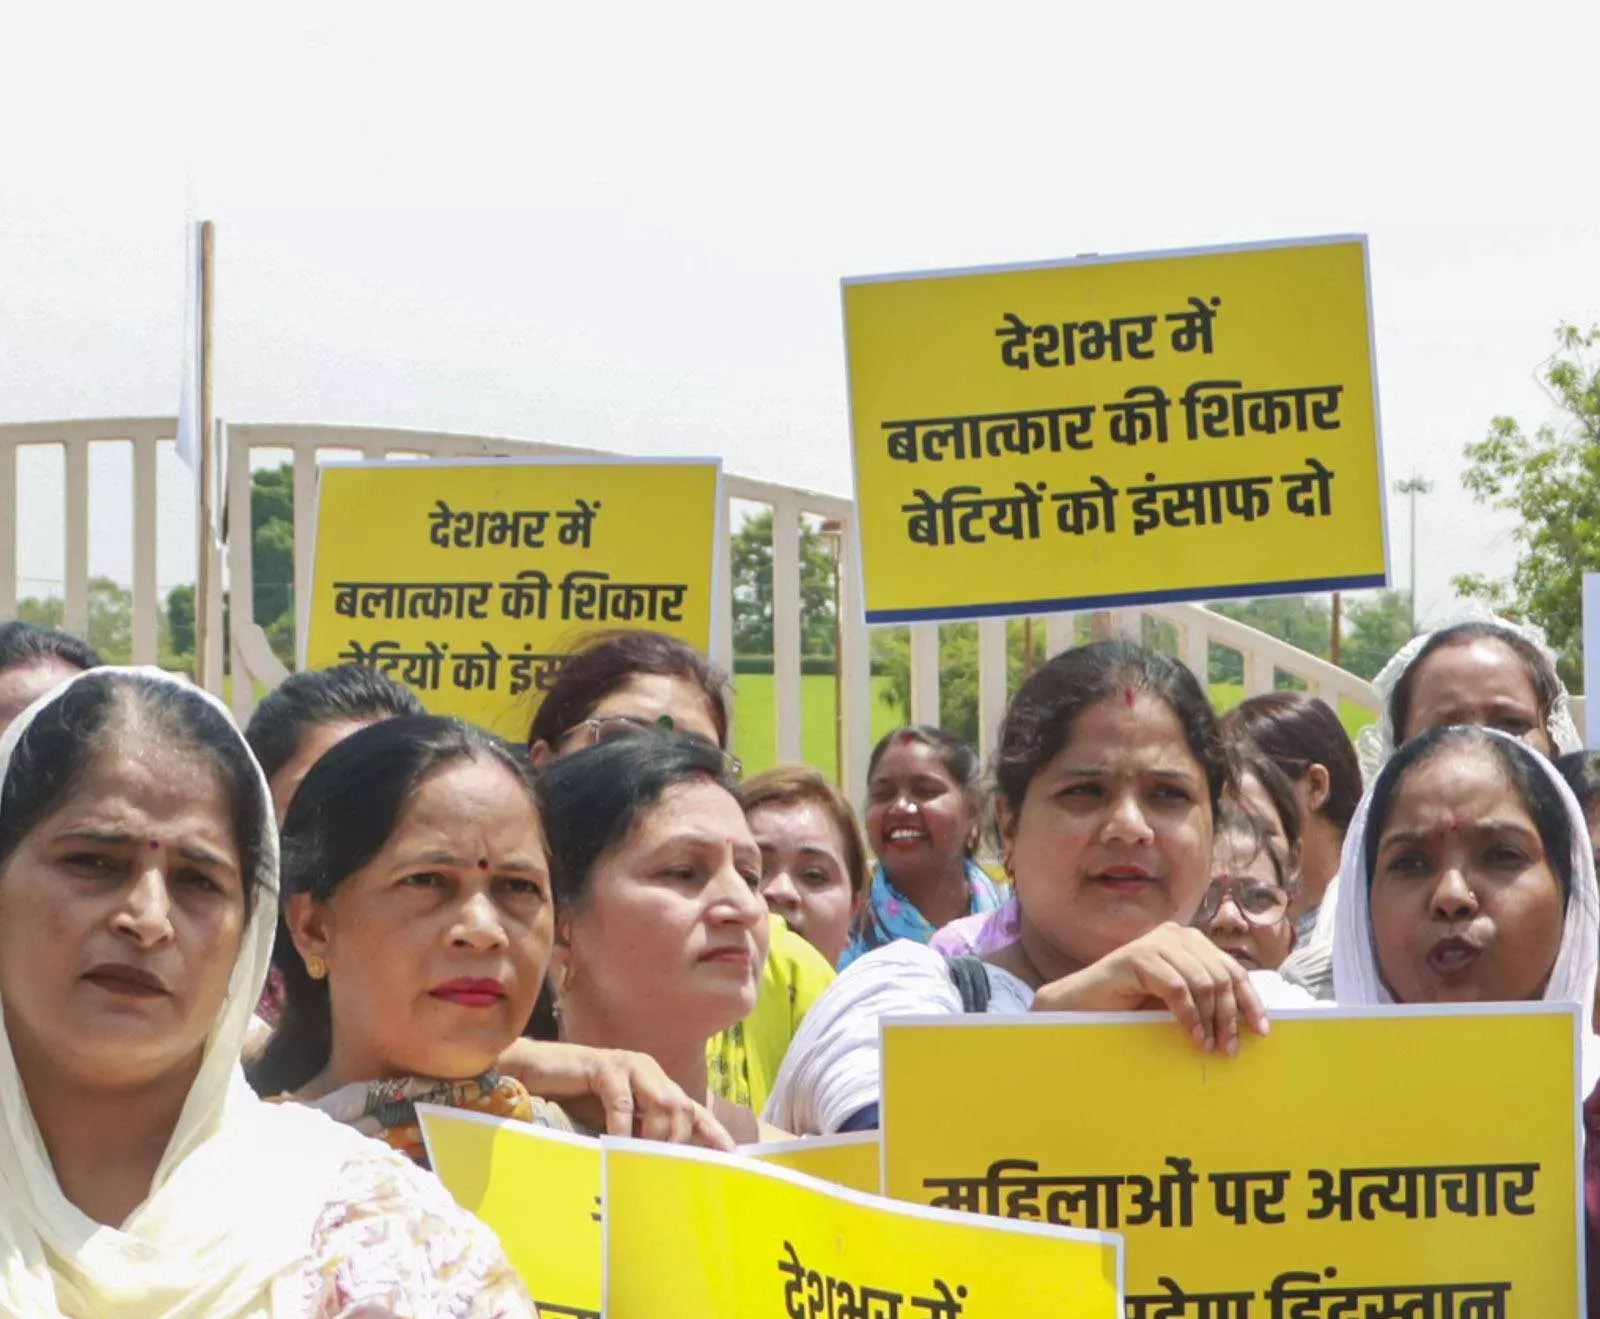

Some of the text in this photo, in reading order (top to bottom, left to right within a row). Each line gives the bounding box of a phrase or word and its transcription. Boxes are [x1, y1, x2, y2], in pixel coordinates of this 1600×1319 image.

[996, 297, 1221, 370] देशभर में
[881, 381, 1343, 462] बलात्कार की शिकार
[429, 499, 601, 548] देशभर में
[902, 458, 1334, 545] बेटियों को इंसाफ दो
[333, 570, 687, 621] बलात्कार की शिकार
[451, 642, 502, 690] को
[1208, 1171, 1290, 1224] पर
[1308, 1163, 1540, 1221] अत्याचार
